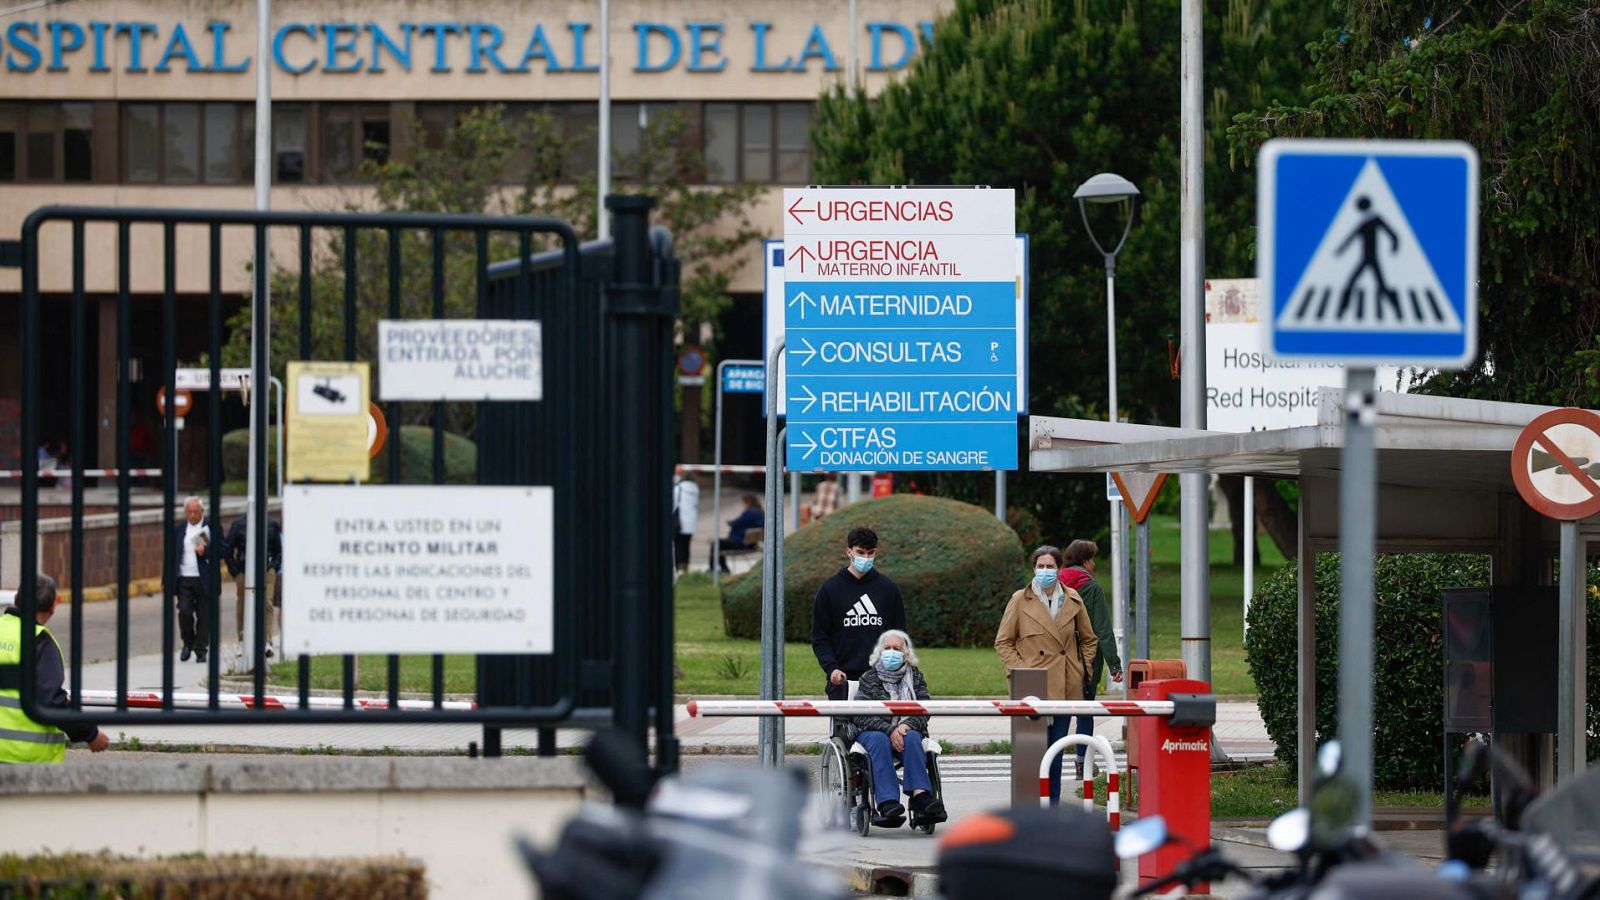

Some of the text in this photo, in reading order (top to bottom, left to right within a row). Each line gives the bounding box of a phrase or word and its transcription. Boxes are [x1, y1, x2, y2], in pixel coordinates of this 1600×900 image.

[0, 21, 251, 74] SPITAL
[271, 21, 601, 74] CENTRAL
[632, 22, 728, 73] DE
[750, 21, 843, 73] LA
[817, 200, 954, 222] URGENCIAS
[817, 240, 939, 261] URGENCIA
[817, 262, 962, 276] MATERNO INFANTIL
[820, 295, 973, 316] MATERNIDAD
[387, 328, 534, 346] PROVEEDORES
[387, 346, 533, 362] ENTRADA POR
[820, 341, 962, 363] CONSULTAS
[454, 363, 531, 380] ALUCHE
[821, 385, 1012, 412] REHABILITACIÓN
[1206, 386, 1318, 413] Red Hospita
[820, 427, 897, 449] CTFAS
[820, 447, 988, 465] DONACIÓN DE SANGRE
[334, 519, 501, 534] ENTRA USTED EN UN
[339, 541, 499, 555] RECINTO MILITAR
[303, 563, 532, 578] RESPETE LAS INDICACIONES DEL
[325, 586, 511, 600] PERSONAL DEL CENTRO Y
[309, 608, 526, 622] DEL PERSONAL DE SEGURIDAD
[843, 613, 883, 627] adidas
[1161, 739, 1208, 754] Aprimatic
